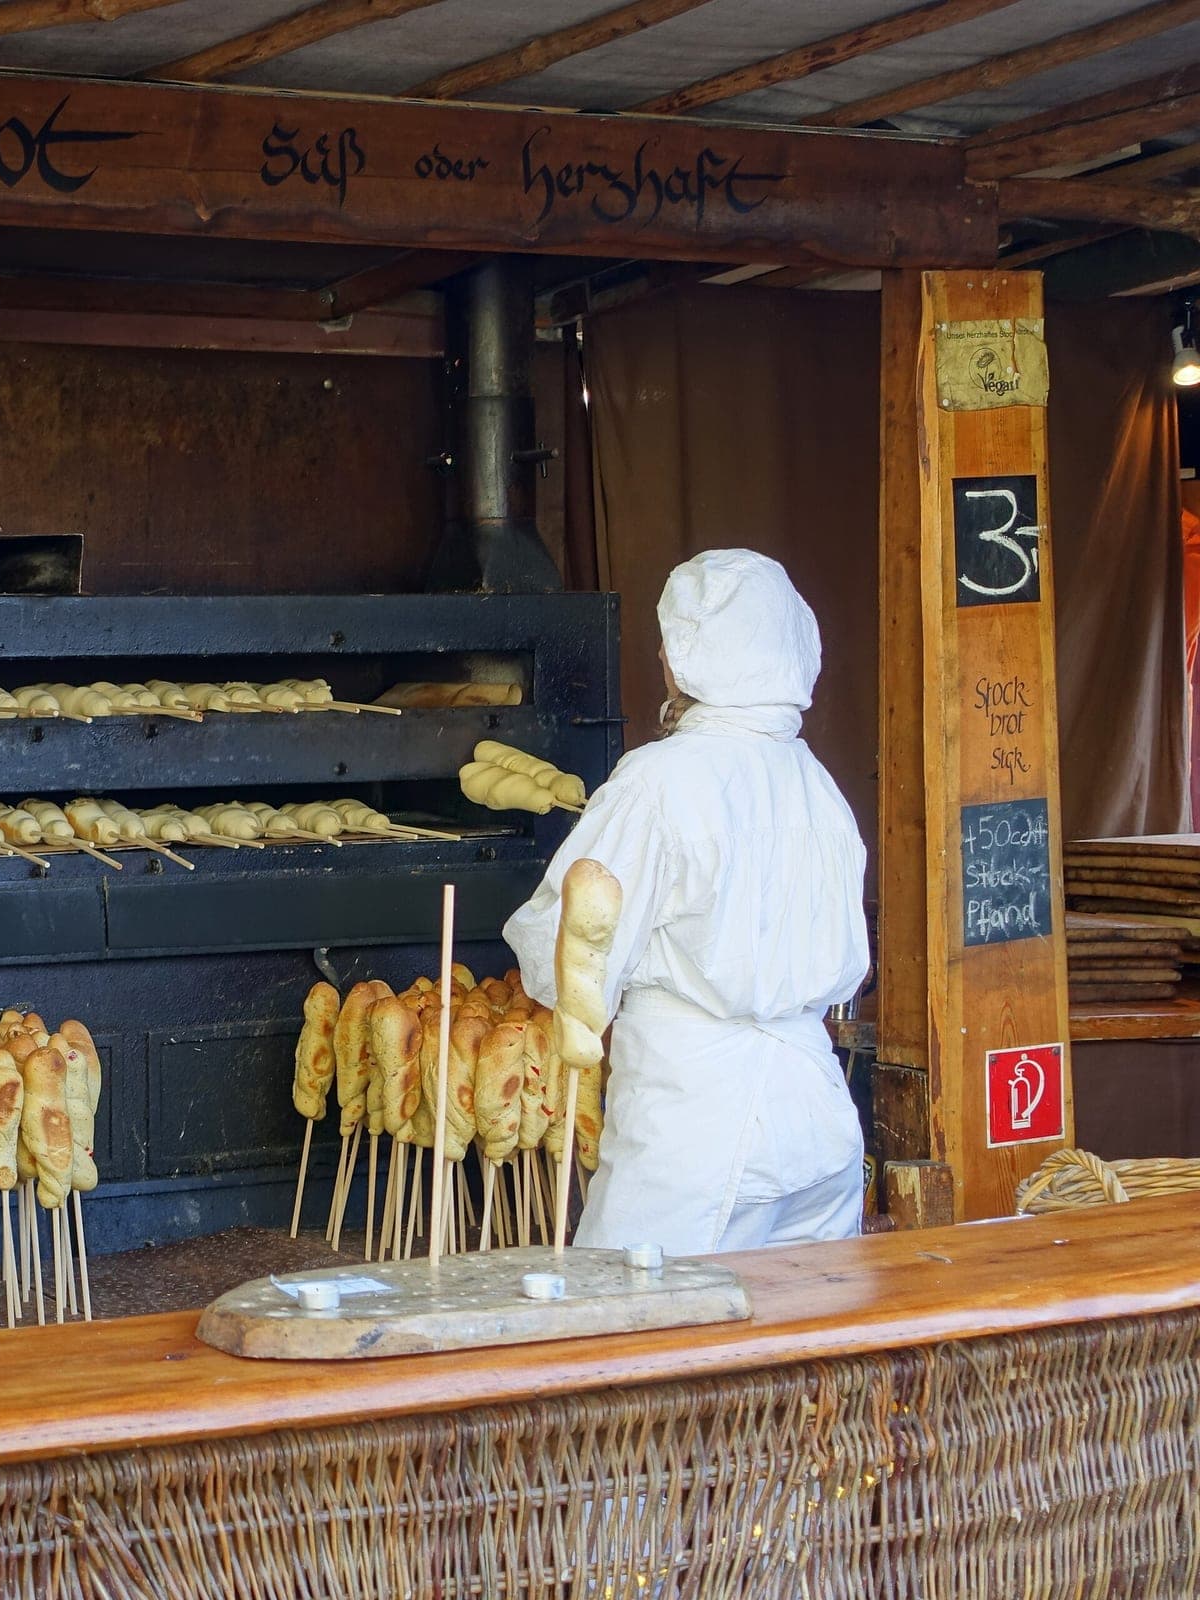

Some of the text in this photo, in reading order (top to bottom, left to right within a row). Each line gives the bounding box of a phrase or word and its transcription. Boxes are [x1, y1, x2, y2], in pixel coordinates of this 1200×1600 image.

[259, 124, 788, 232] Süß oder herzhaft
[990, 711, 1027, 736] brot
[967, 892, 1040, 937] Pfand
